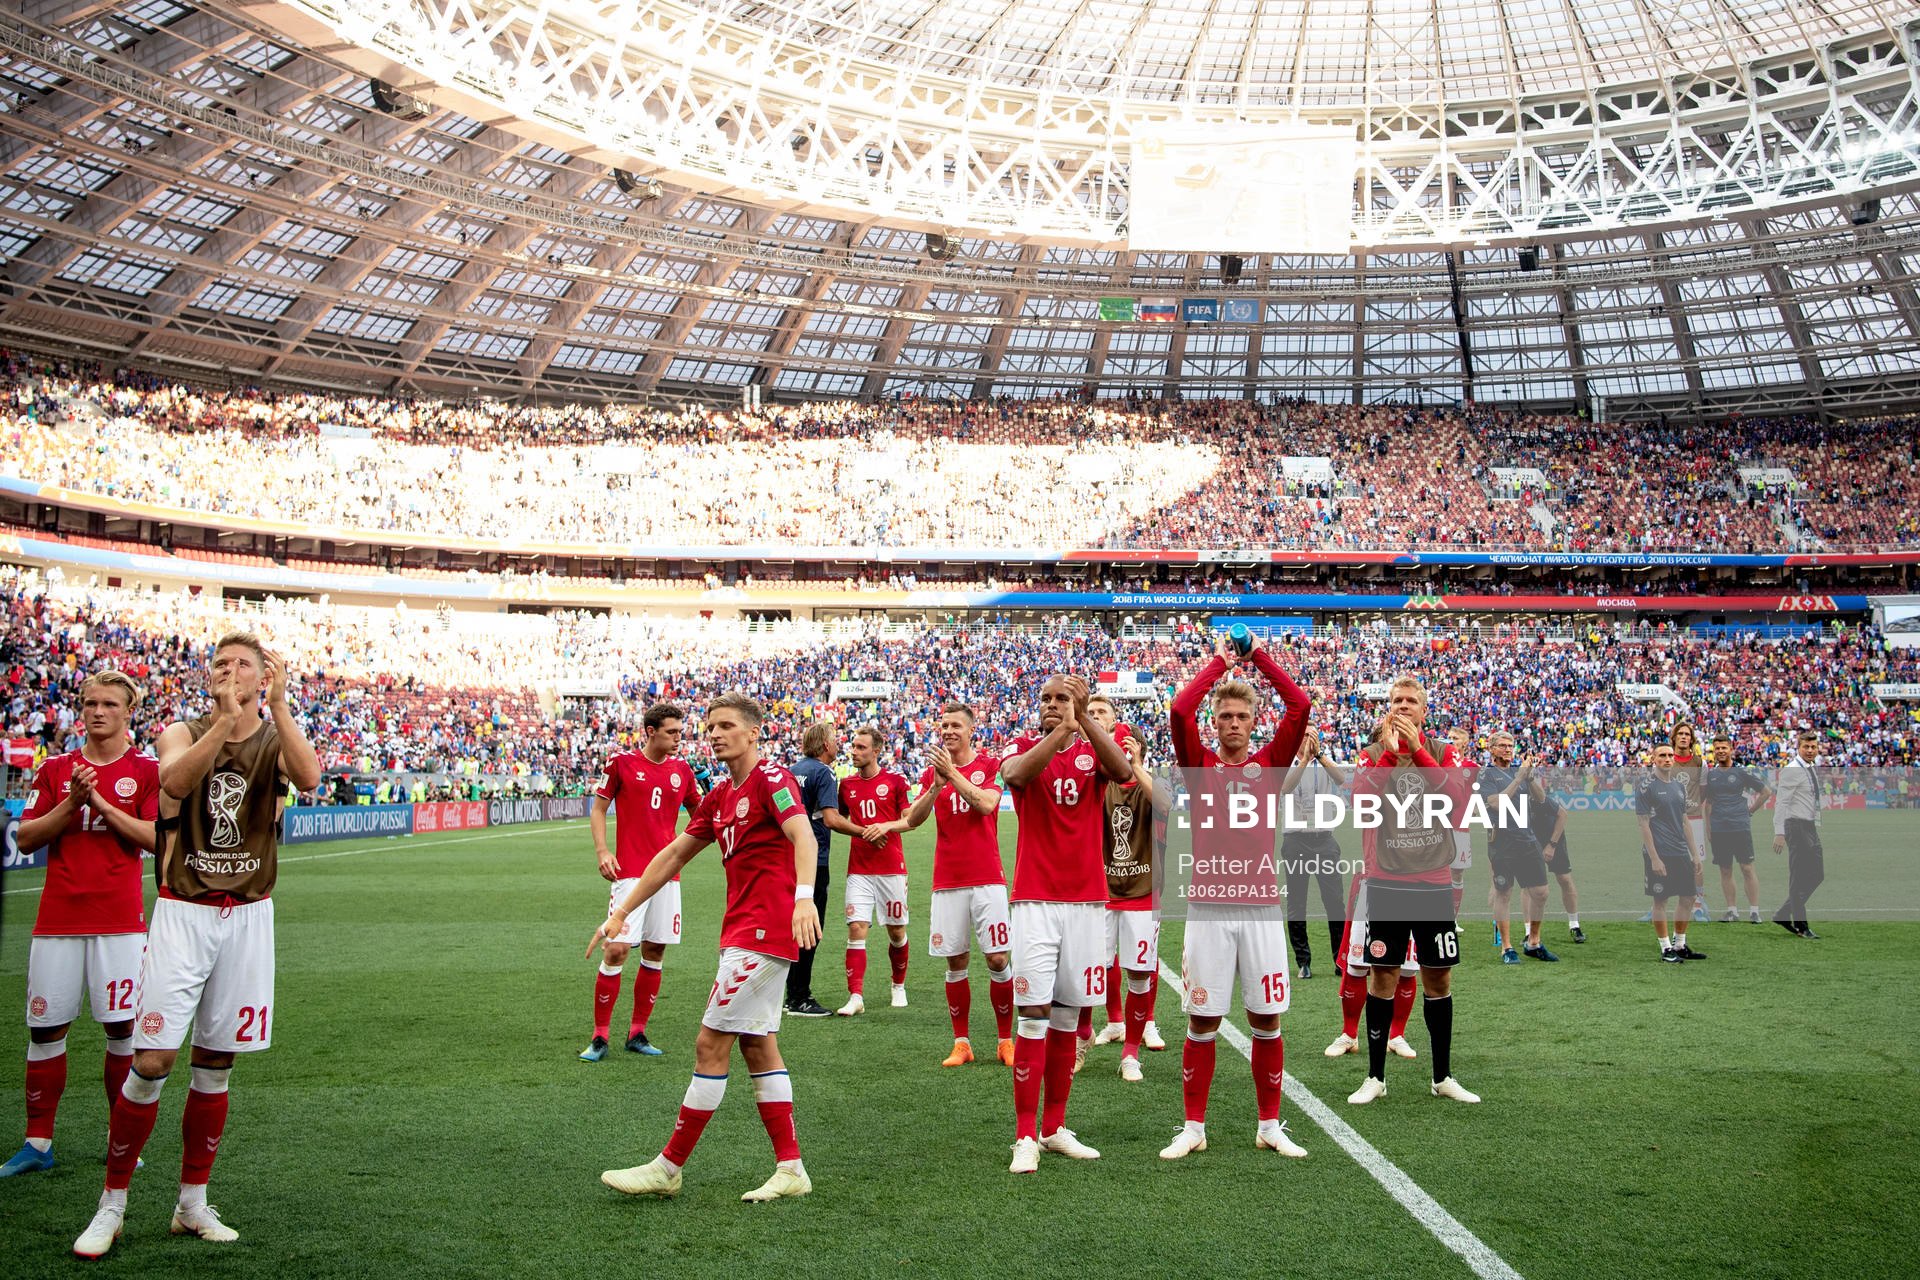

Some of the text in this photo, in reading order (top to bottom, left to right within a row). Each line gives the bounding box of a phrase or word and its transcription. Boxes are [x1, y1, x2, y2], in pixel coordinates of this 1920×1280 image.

[1188, 305, 1212, 315] FIFA
[1489, 555, 1711, 564] ЧЕМПИОНАТ МИРА ПО ФУТБОЛУ FIFA 2018 В РОССИИ
[1112, 595, 1240, 604] 2018 FIFA WORLD CUP RUSSIA
[1597, 598, 1637, 607] МОСКВА
[651, 787, 662, 809] 6
[1053, 778, 1079, 805] 13
[502, 799, 541, 824] KIA MOTORS
[860, 799, 877, 819] 10
[950, 792, 969, 814] 18
[292, 809, 407, 837] 2018 FIFA WORLD CUP RUSSIA
[723, 825, 735, 859] 11
[1386, 837, 1426, 849] RUSSIA
[210, 852, 237, 860] WORLD
[234, 858, 260, 873] 201
[1129, 863, 1150, 876] 2018
[886, 901, 902, 919] 10
[673, 913, 681, 936] 6
[988, 922, 1009, 947] 18
[1137, 940, 1148, 964] 2
[1435, 931, 1457, 959] 16
[1083, 965, 1105, 996] 13
[1261, 972, 1285, 1004] 15
[106, 978, 133, 1011] 12
[236, 1005, 267, 1042] 21
